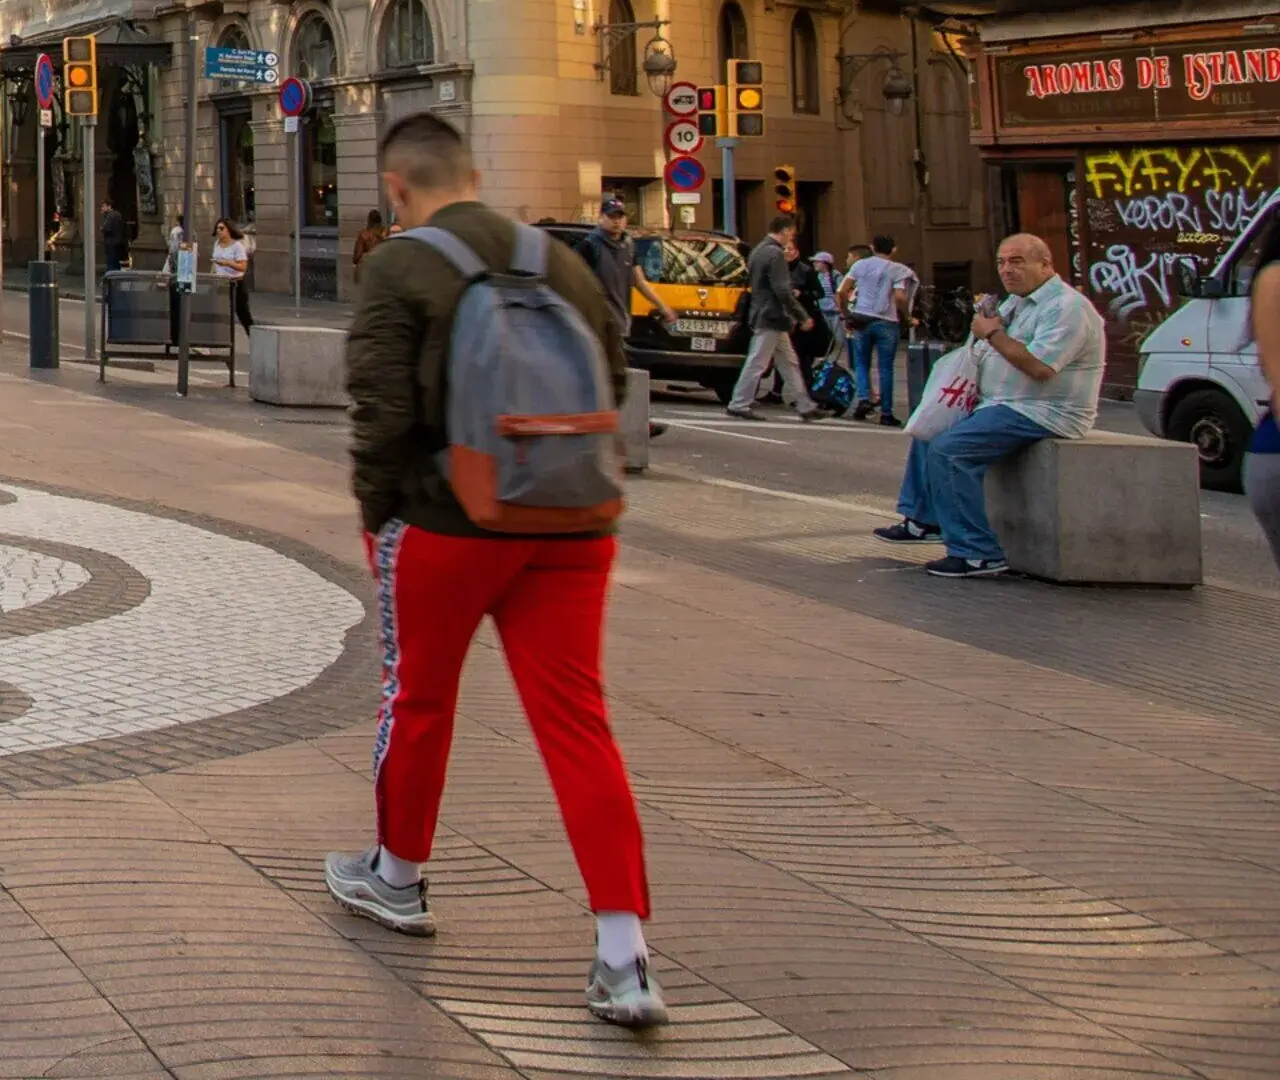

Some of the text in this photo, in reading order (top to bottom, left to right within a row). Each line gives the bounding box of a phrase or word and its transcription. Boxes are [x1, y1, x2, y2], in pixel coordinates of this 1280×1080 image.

[1024, 47, 1280, 101] AROMAS DE ISTANB
[676, 131, 694, 142] 10
